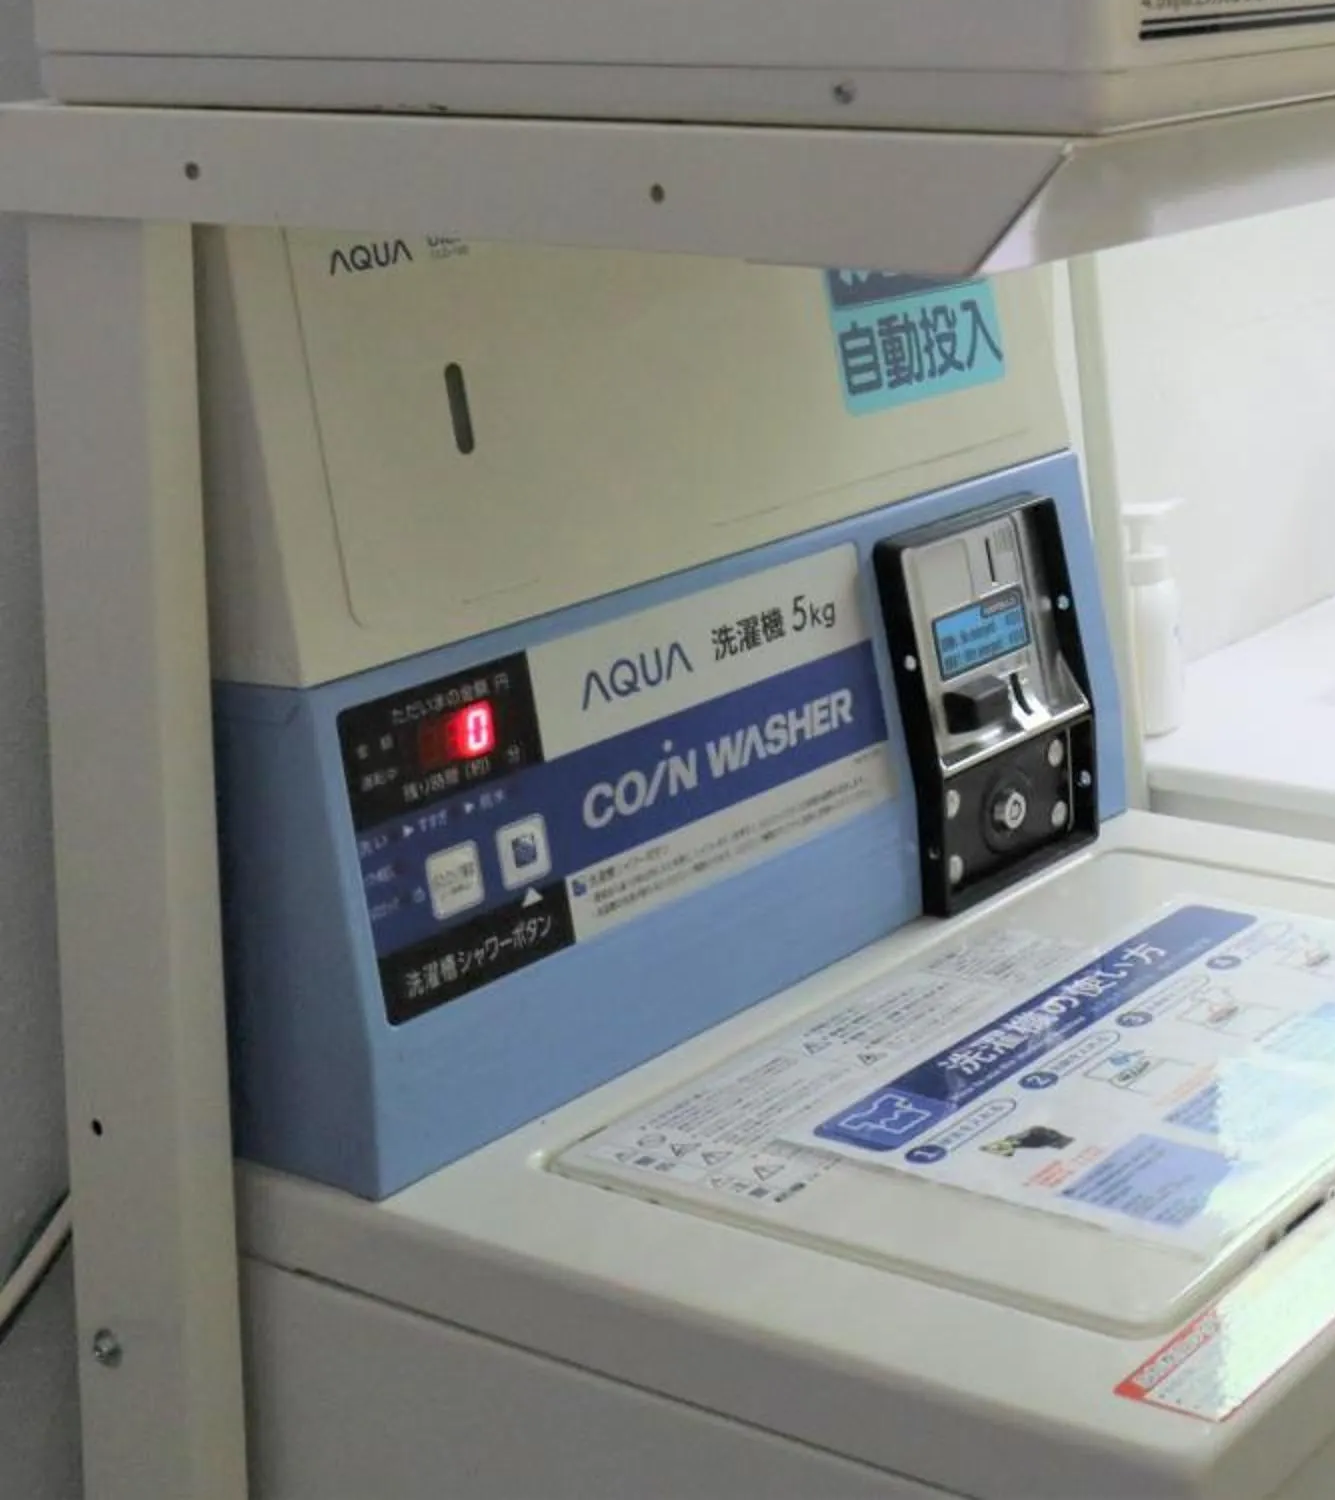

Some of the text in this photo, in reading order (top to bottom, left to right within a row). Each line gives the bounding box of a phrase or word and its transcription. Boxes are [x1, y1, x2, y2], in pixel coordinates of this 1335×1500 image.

[330, 239, 414, 276] AQUA
[838, 299, 1004, 396] 自動投入
[582, 595, 837, 711] AQUA 洗濯機 5kg
[466, 707, 489, 751] 0
[705, 688, 855, 780] WASHER
[937, 942, 1167, 1077] 洗濯機の使い方
